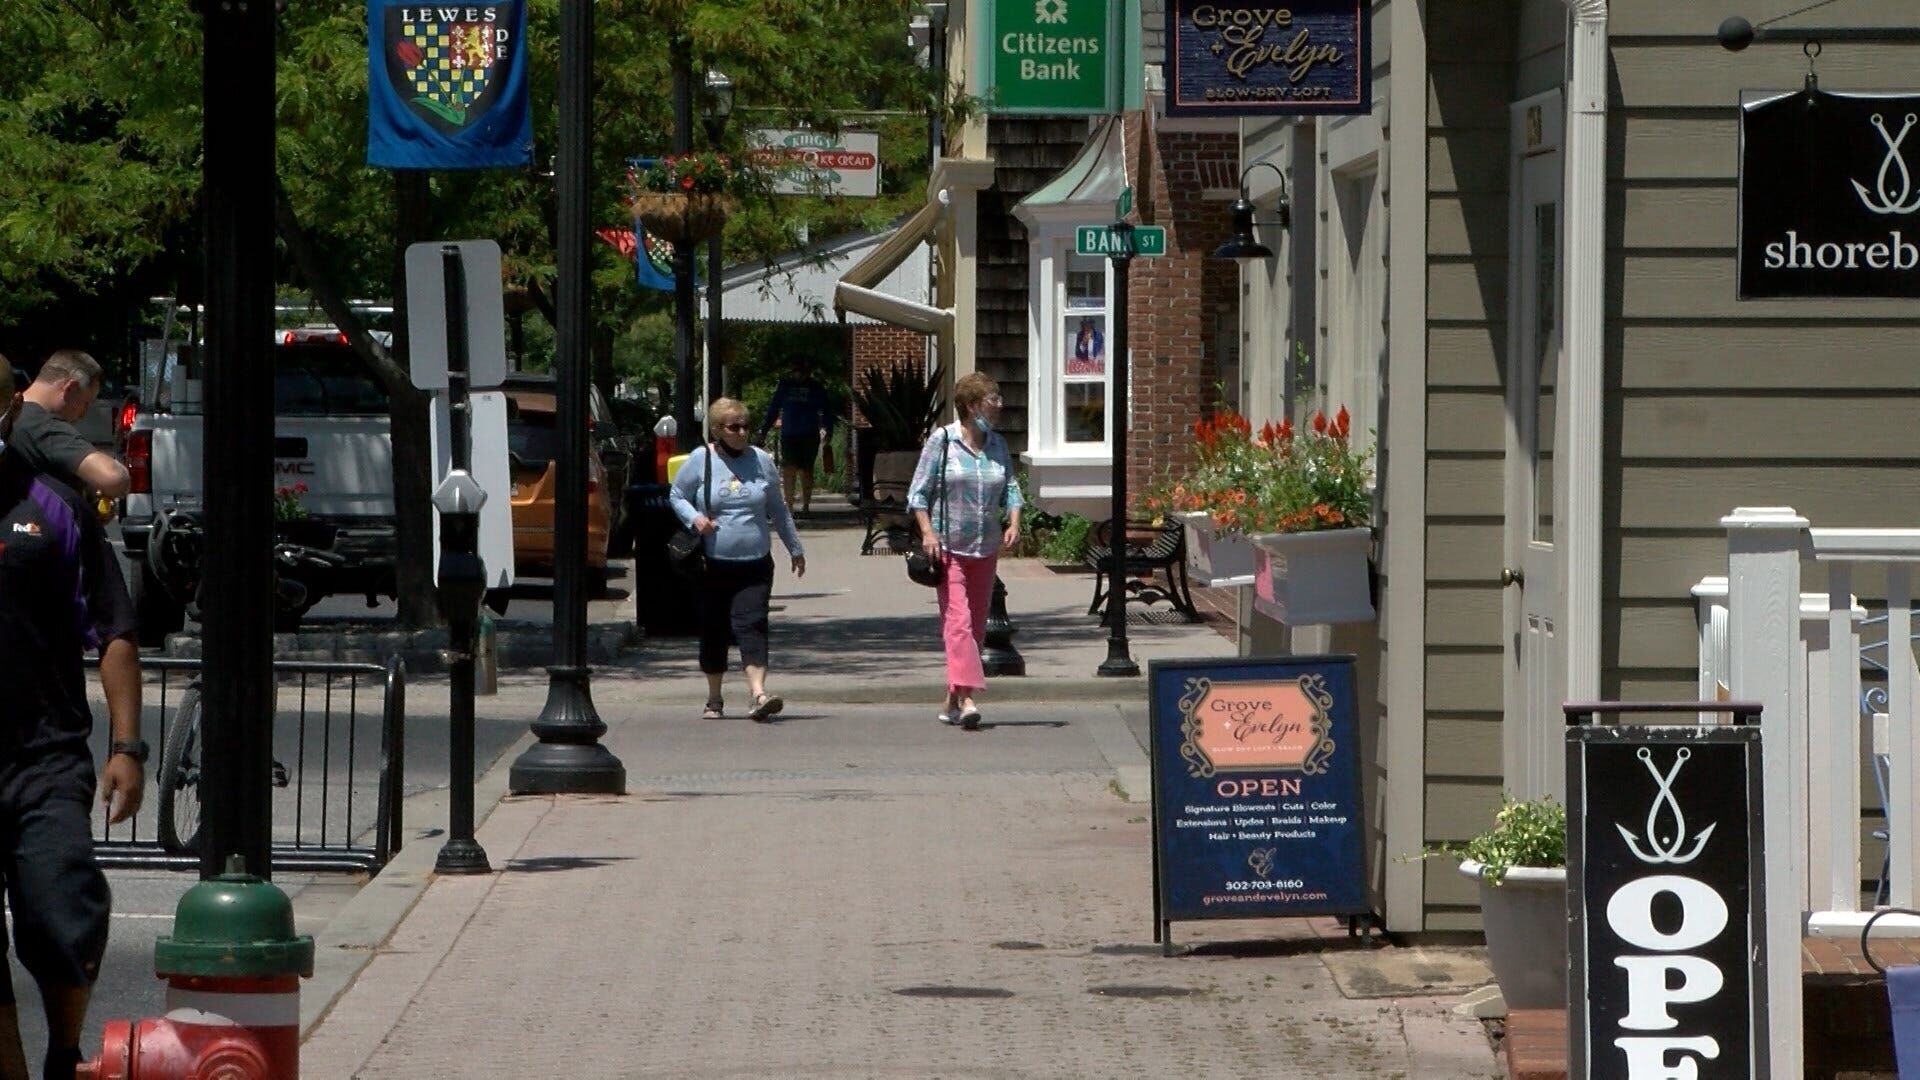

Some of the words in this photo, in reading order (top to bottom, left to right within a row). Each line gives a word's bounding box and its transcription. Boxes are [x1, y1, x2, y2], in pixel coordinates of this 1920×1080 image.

[402, 8, 496, 22] LEWES
[1193, 5, 1292, 26] Grove
[1002, 33, 1099, 55] Citizens
[1223, 25, 1345, 82] Evelyn
[1020, 58, 1081, 80] Bank
[1292, 87, 1331, 97] LOFT
[1142, 235, 1156, 247] ST
[1764, 230, 1919, 269] shoreb
[275, 462, 315, 474] MC
[1211, 699, 1273, 712] Grove
[1230, 712, 1304, 744] Evelyn
[1217, 779, 1302, 798] OPEN
[1184, 805, 1231, 815] Signature
[1232, 803, 1276, 812] Blowouts
[1311, 801, 1337, 810] Color
[1176, 819, 1228, 828] Extensions
[1234, 817, 1265, 827] Updos
[1271, 816, 1302, 824] Braids
[1309, 815, 1347, 825] Makeup
[1209, 832, 1230, 840] Hair
[1238, 831, 1272, 840] Beauty
[1274, 829, 1316, 838] Products
[1202, 891, 1328, 906] groveandevelyn.com
